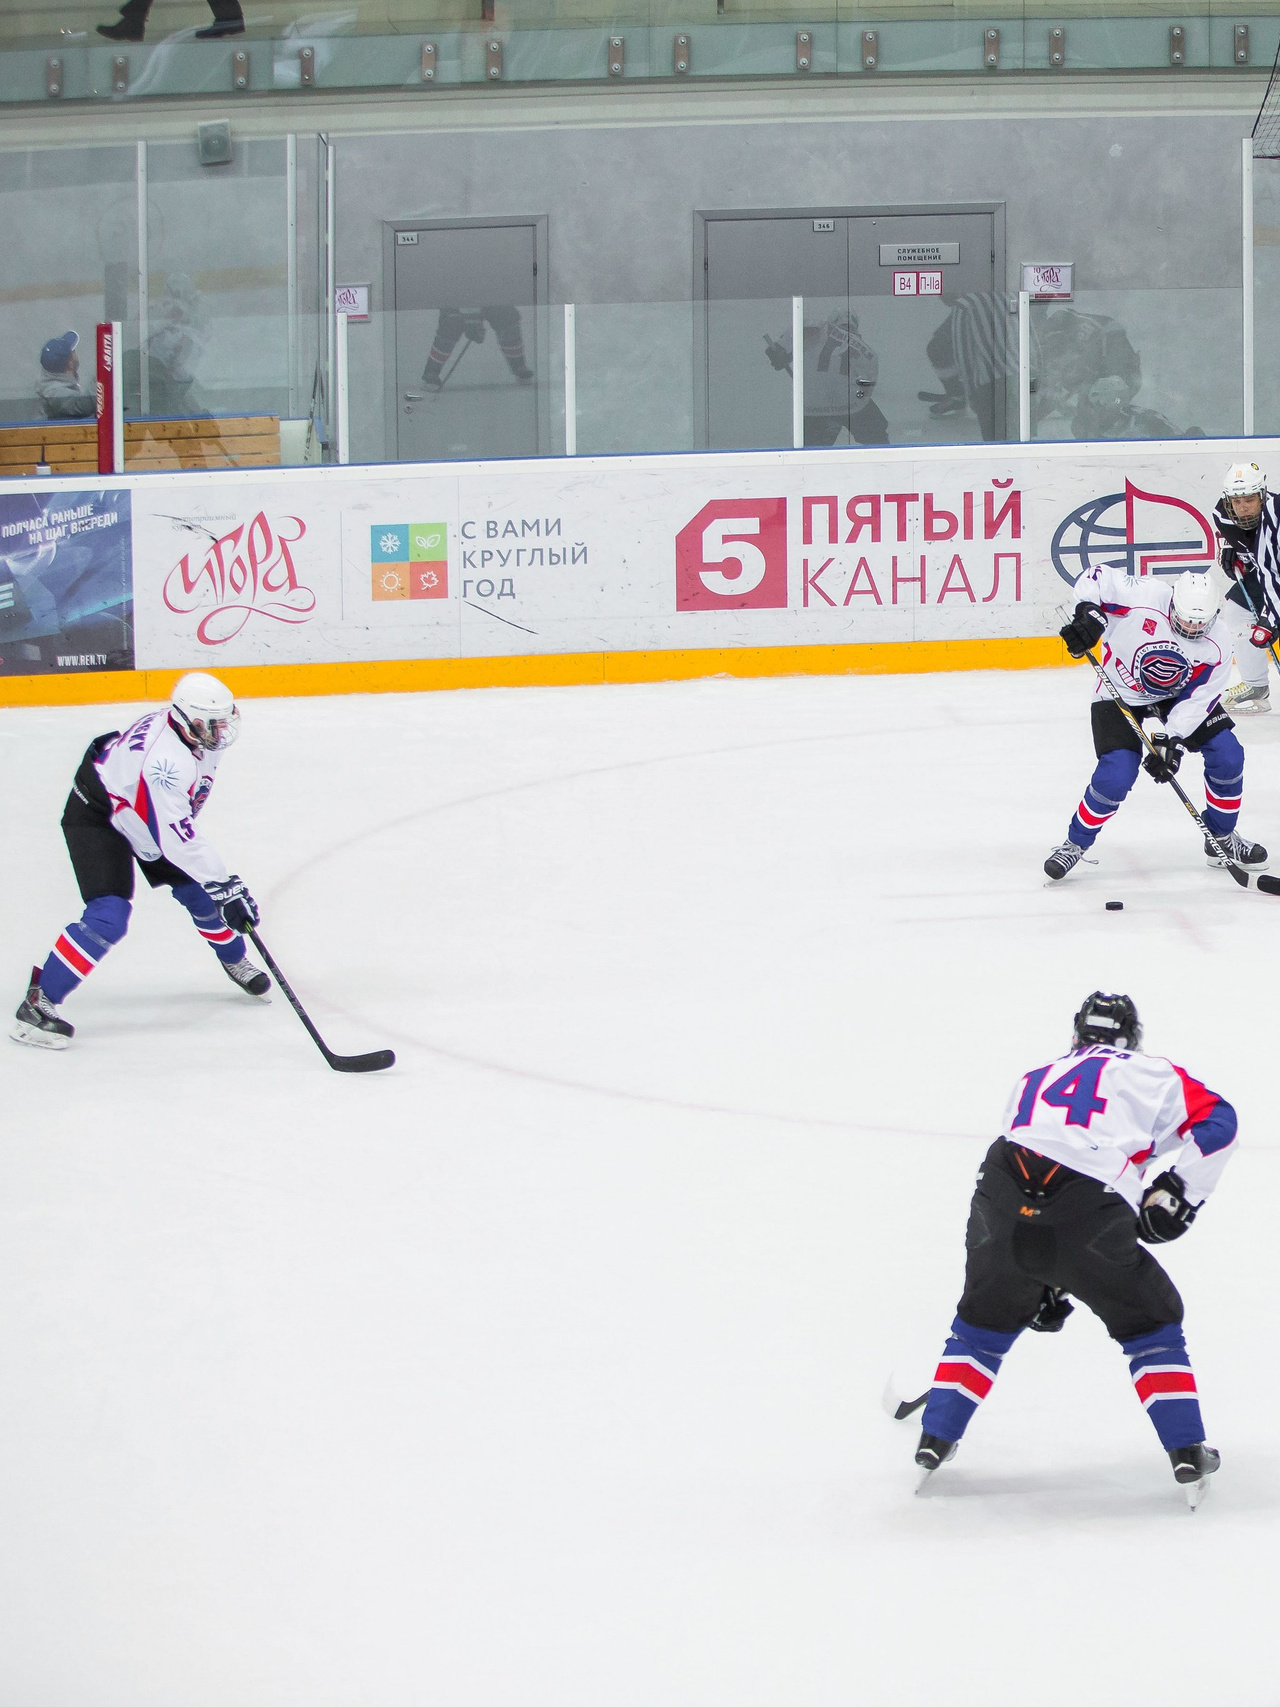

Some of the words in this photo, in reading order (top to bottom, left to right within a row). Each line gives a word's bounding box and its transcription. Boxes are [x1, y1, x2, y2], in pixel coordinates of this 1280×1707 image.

[2, 513, 48, 538] ПОЛЧАСА
[50, 504, 94, 526] РАНЬШЕ
[29, 531, 43, 545] НА
[45, 525, 68, 542] ШАГ
[70, 512, 118, 533] ВПЕРЕДИ
[460, 521, 476, 540] С
[486, 518, 563, 538] ВАМИ
[802, 478, 1023, 546] ПЯТЫЙ
[461, 546, 589, 570] КРУГЛЫЙ
[699, 516, 767, 596] 5
[461, 578, 516, 600] ГОД
[802, 553, 1022, 608] КАНАЛ
[57, 653, 107, 667] WWW.REN.TV
[1093, 664, 1119, 699] BAUER
[168, 816, 196, 843] 15
[1194, 816, 1232, 867] SUPREME
[1011, 1056, 1111, 1131] 14
